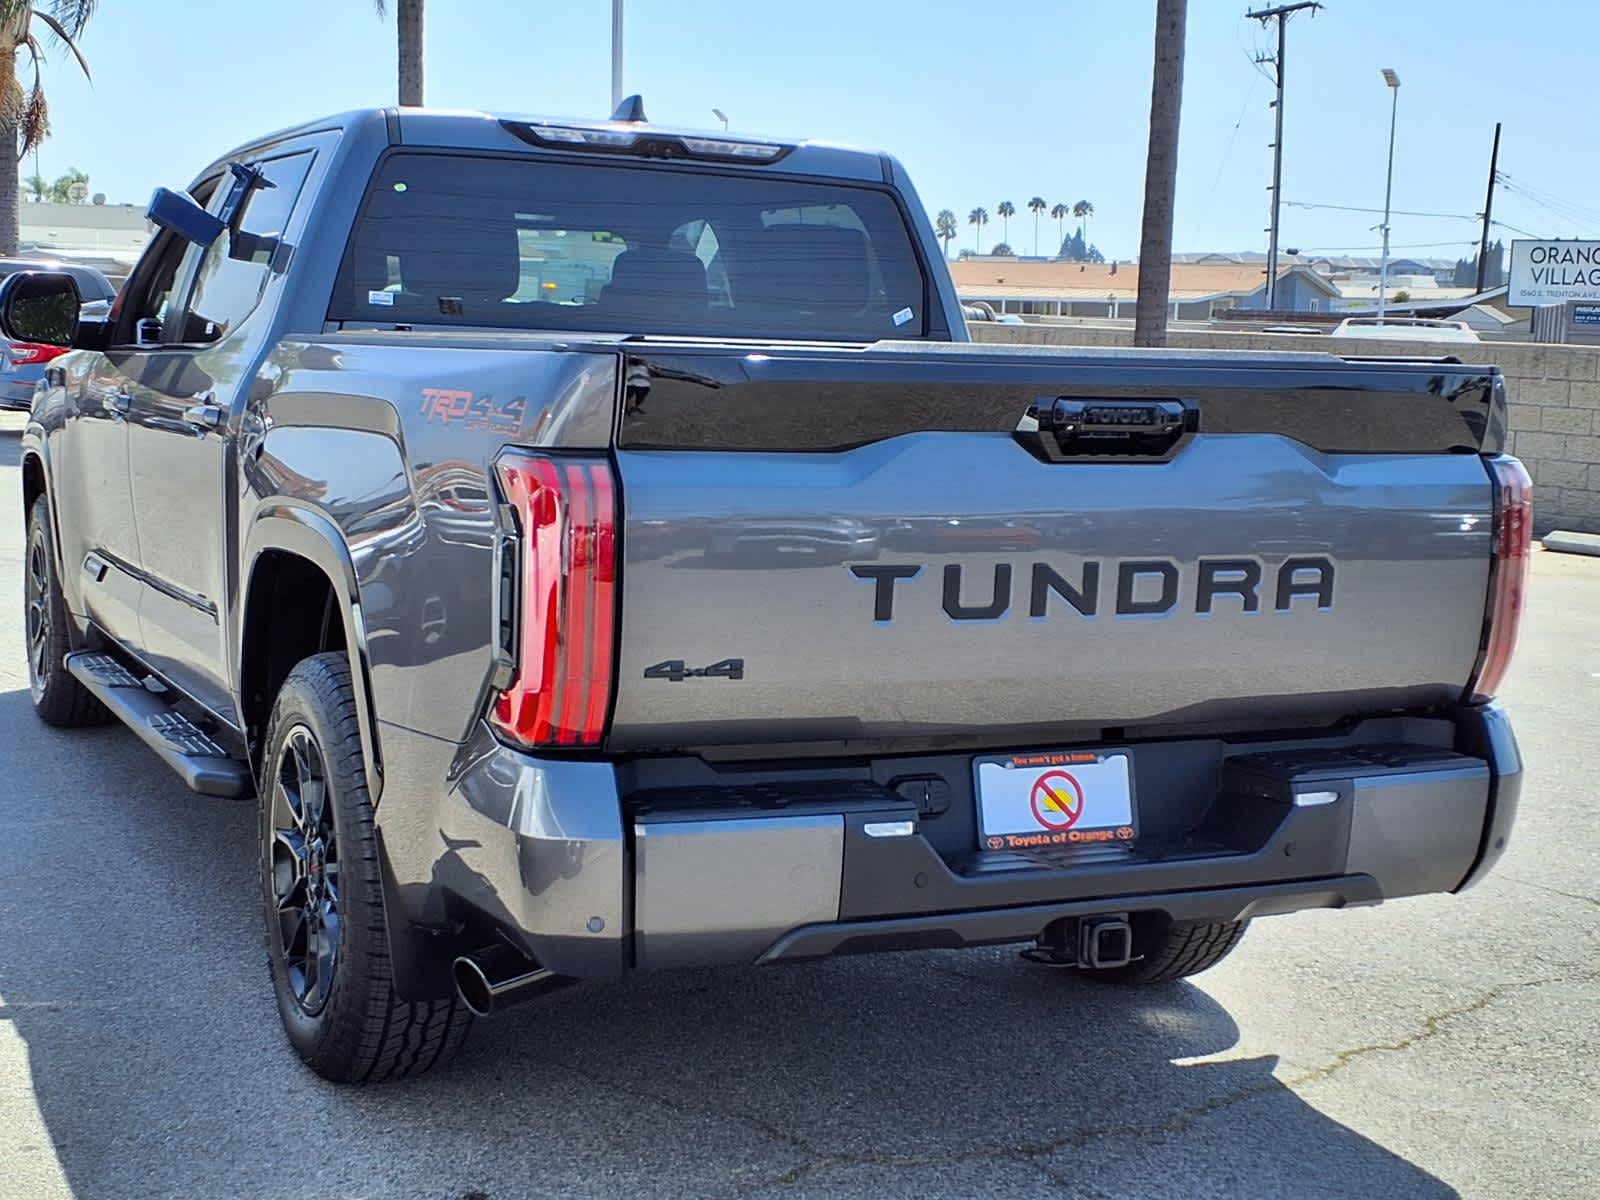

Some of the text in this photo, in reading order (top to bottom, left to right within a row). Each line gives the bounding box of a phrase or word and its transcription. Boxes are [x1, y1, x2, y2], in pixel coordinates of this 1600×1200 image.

[419, 388, 473, 424] TRD
[1088, 408, 1152, 424] TOYOTA
[850, 556, 1336, 623] TUNDRA
[643, 658, 744, 682] 4x4
[1006, 829, 1114, 848] Toyota of Orange
